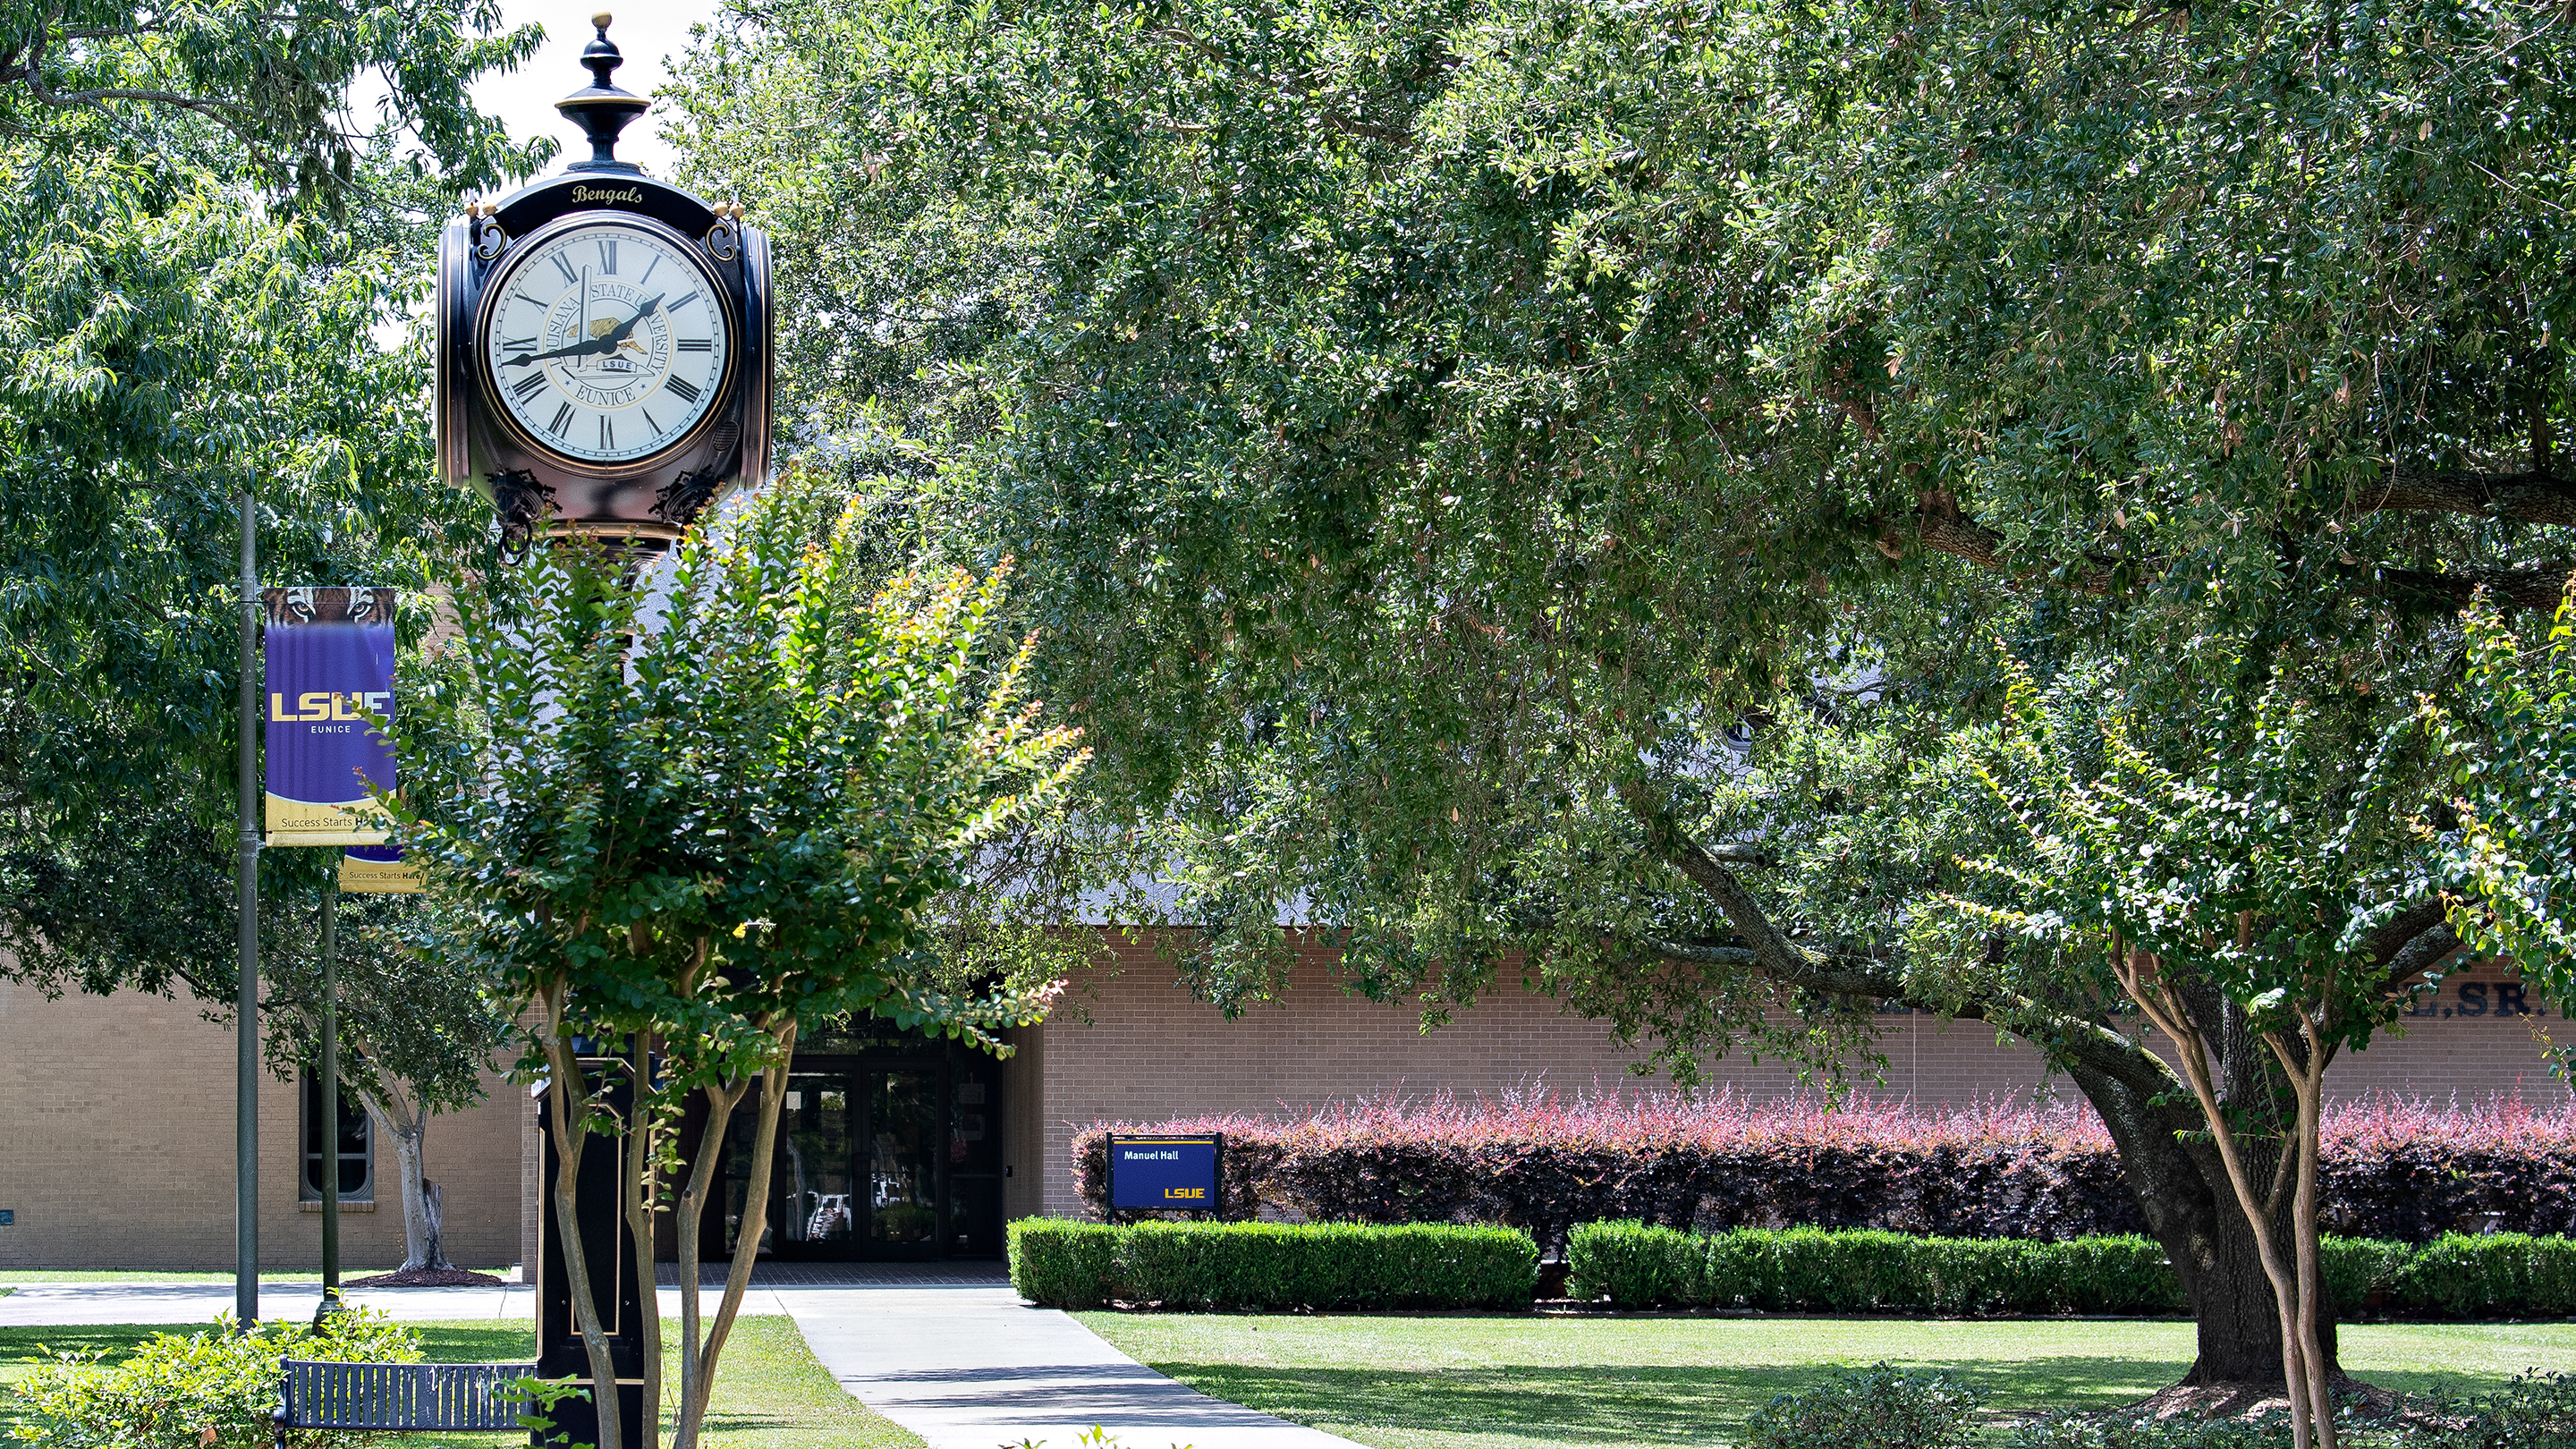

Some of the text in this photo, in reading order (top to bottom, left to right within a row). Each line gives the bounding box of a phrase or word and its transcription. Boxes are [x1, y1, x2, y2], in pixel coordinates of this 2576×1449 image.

[572, 184, 643, 206] Bengals
[597, 240, 617, 275] XII
[590, 284, 635, 301] STATE
[602, 360, 632, 369] LSUE
[575, 385, 637, 407] EUNICE
[271, 691, 391, 722] LSUE
[310, 725, 352, 733] EUNICE
[281, 818, 321, 827] Success
[323, 817, 352, 826] Starts
[349, 871, 378, 879] Success
[379, 871, 401, 879] Starts
[1123, 1150, 1179, 1160] Manuel Hall
[1165, 1188, 1206, 1199] LSUE
